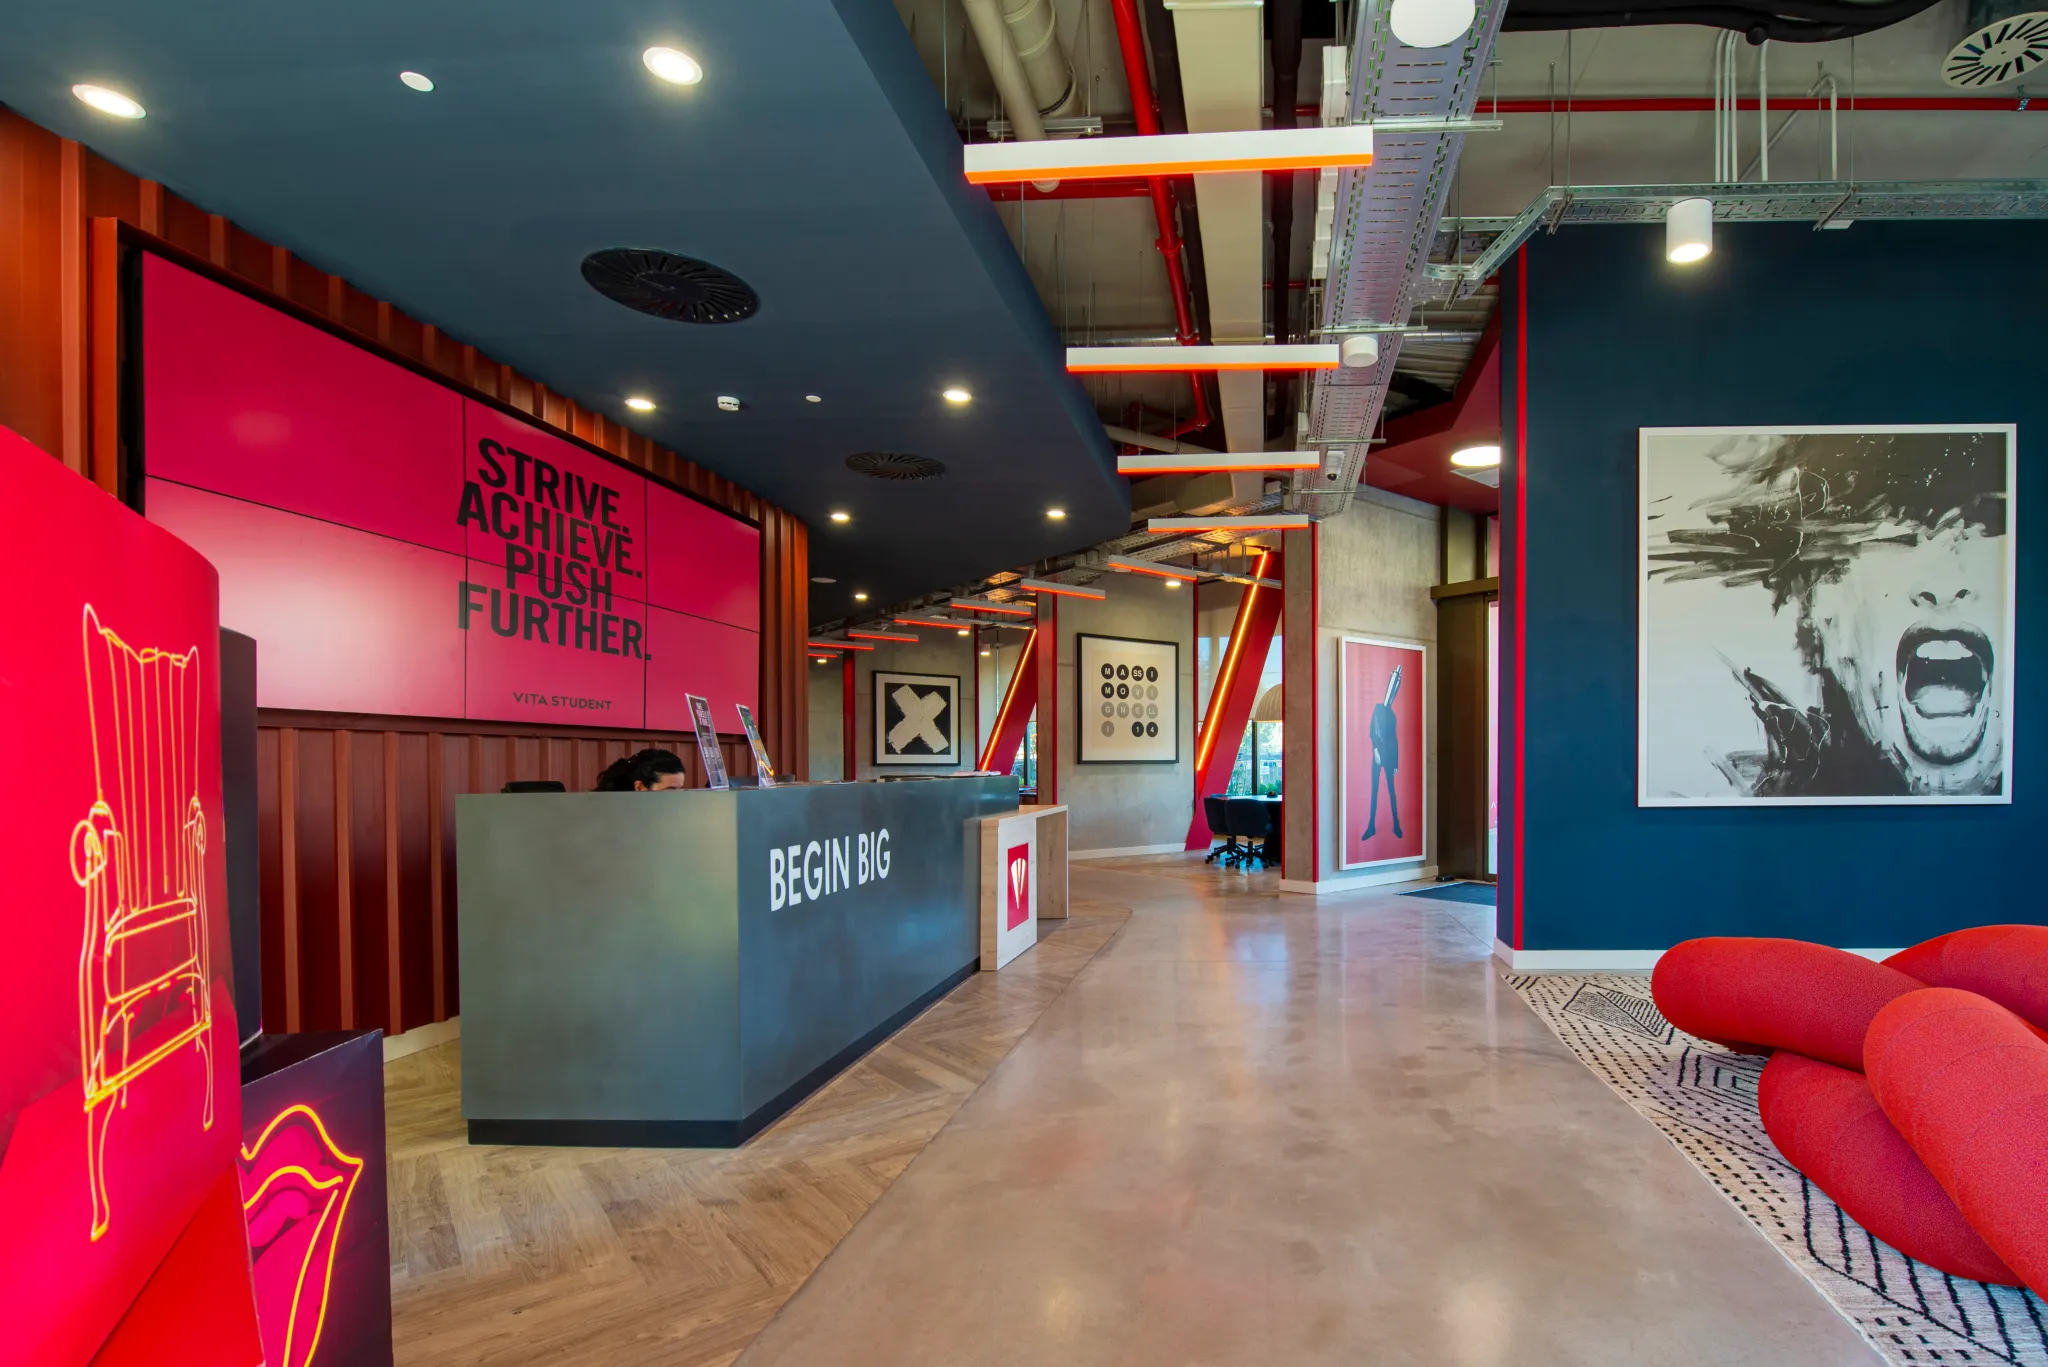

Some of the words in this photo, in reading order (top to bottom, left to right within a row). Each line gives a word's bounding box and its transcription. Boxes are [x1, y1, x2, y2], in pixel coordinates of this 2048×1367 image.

[478, 438, 630, 534] STRIVE.
[456, 480, 643, 579] ACHIEVE.
[506, 542, 612, 613] PUSH
[458, 581, 653, 661] FURTHER.
[513, 692, 548, 706] VITA
[551, 695, 613, 710] STUDENT
[770, 836, 850, 912] BEGIN
[858, 828, 891, 886] BIG
